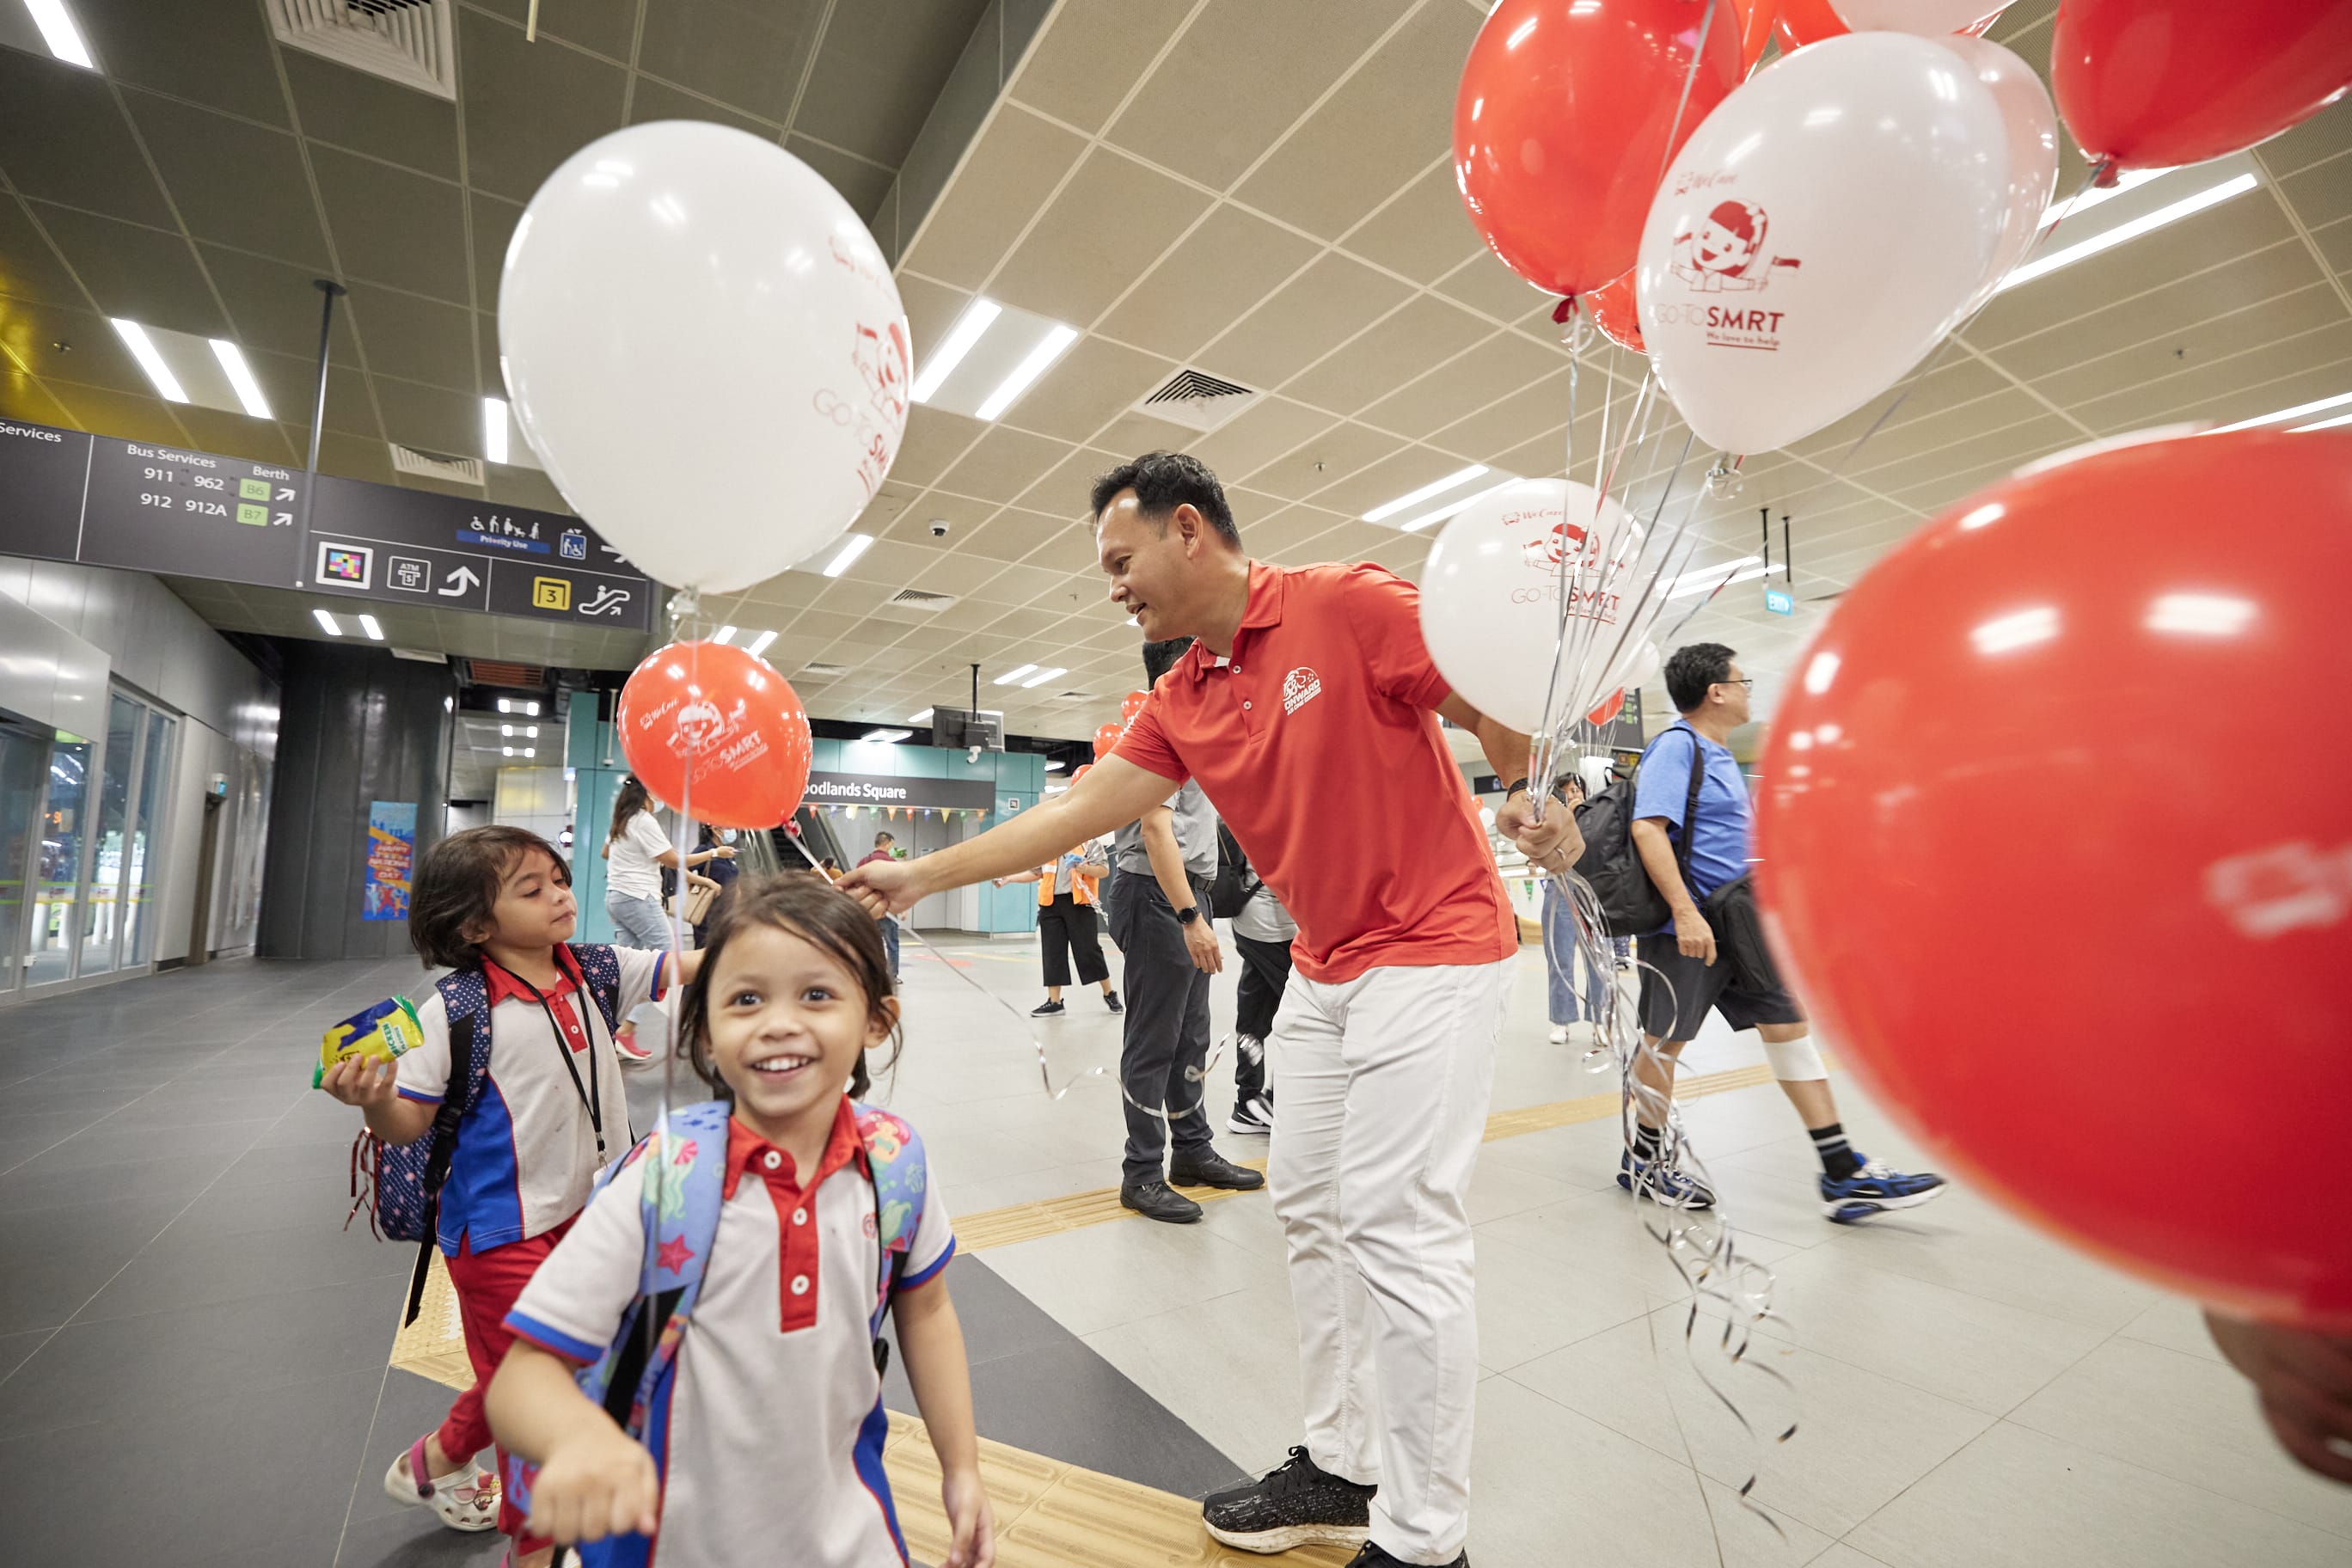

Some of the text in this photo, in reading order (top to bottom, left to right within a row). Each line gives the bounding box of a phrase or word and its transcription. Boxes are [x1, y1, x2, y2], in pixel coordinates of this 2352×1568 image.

[1706, 306, 1785, 333] SMRT
[1706, 332, 1780, 347] We love to help
[0, 421, 63, 443] Services
[127, 444, 217, 469] Bus Services
[144, 467, 224, 491] 911 962
[253, 465, 291, 481] Berth
[247, 484, 265, 496] B6
[140, 493, 228, 517] 912 912A
[244, 509, 261, 519] B7
[480, 535, 529, 549] Priority Use
[400, 563, 420, 572] ATM
[546, 589, 557, 603] 3
[862, 783, 907, 800] Square
